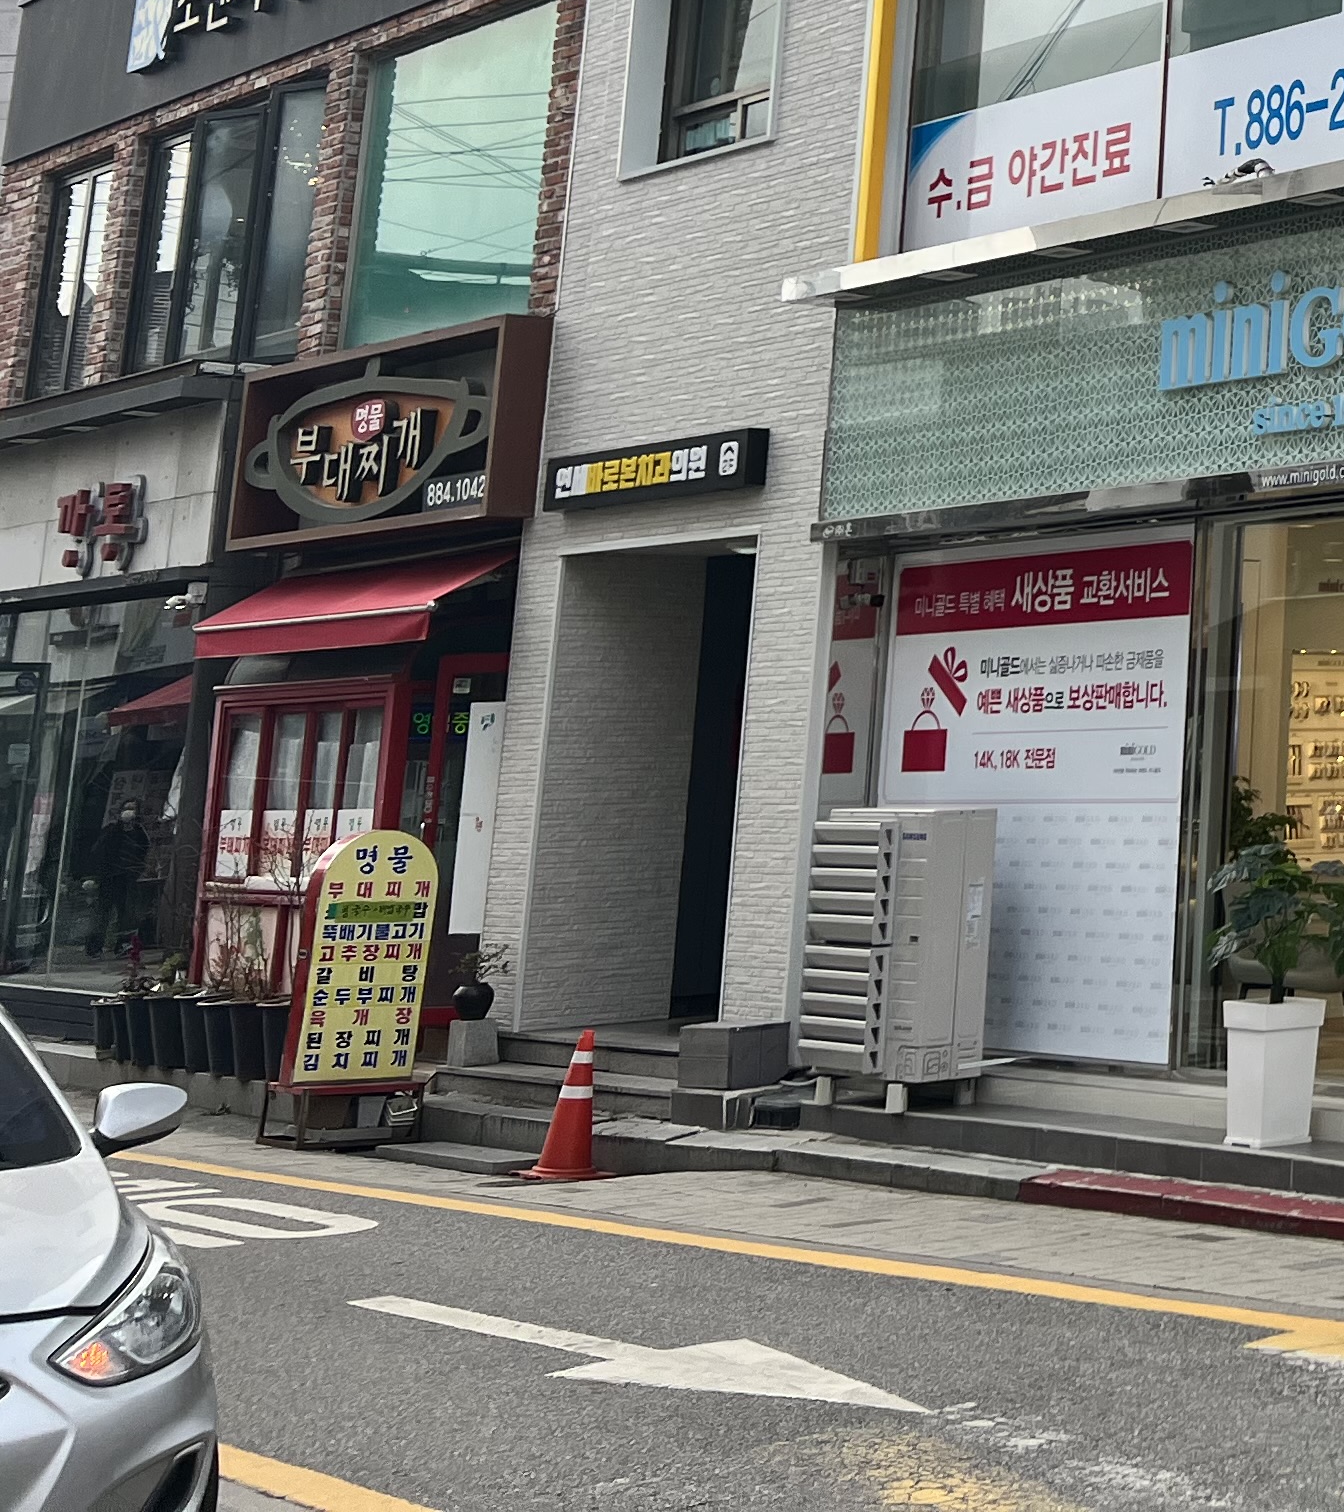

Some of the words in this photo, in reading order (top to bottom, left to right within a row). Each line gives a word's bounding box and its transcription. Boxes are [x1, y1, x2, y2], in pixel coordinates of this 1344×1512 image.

[928, 155, 994, 219] 수.금
[1009, 122, 1132, 199] 야간진료
[355, 403, 384, 433] 명물
[1253, 395, 1329, 435] since
[290, 407, 422, 503] 부대찌개
[554, 445, 707, 500] 연세바로본치과의원
[427, 475, 486, 507] 884.1042
[1011, 568, 1074, 613] 새상품
[1080, 567, 1169, 606] 교환서비스
[977, 688, 1002, 714] 예쁜
[1006, 686, 1064, 713] 새상품으로
[1067, 680, 1168, 711] 보상판매합니다.
[413, 712, 469, 734] 영중
[1024, 748, 1056, 769] 전문점
[356, 845, 413, 874] 명물
[322, 923, 425, 941] 뚝배기불고기
